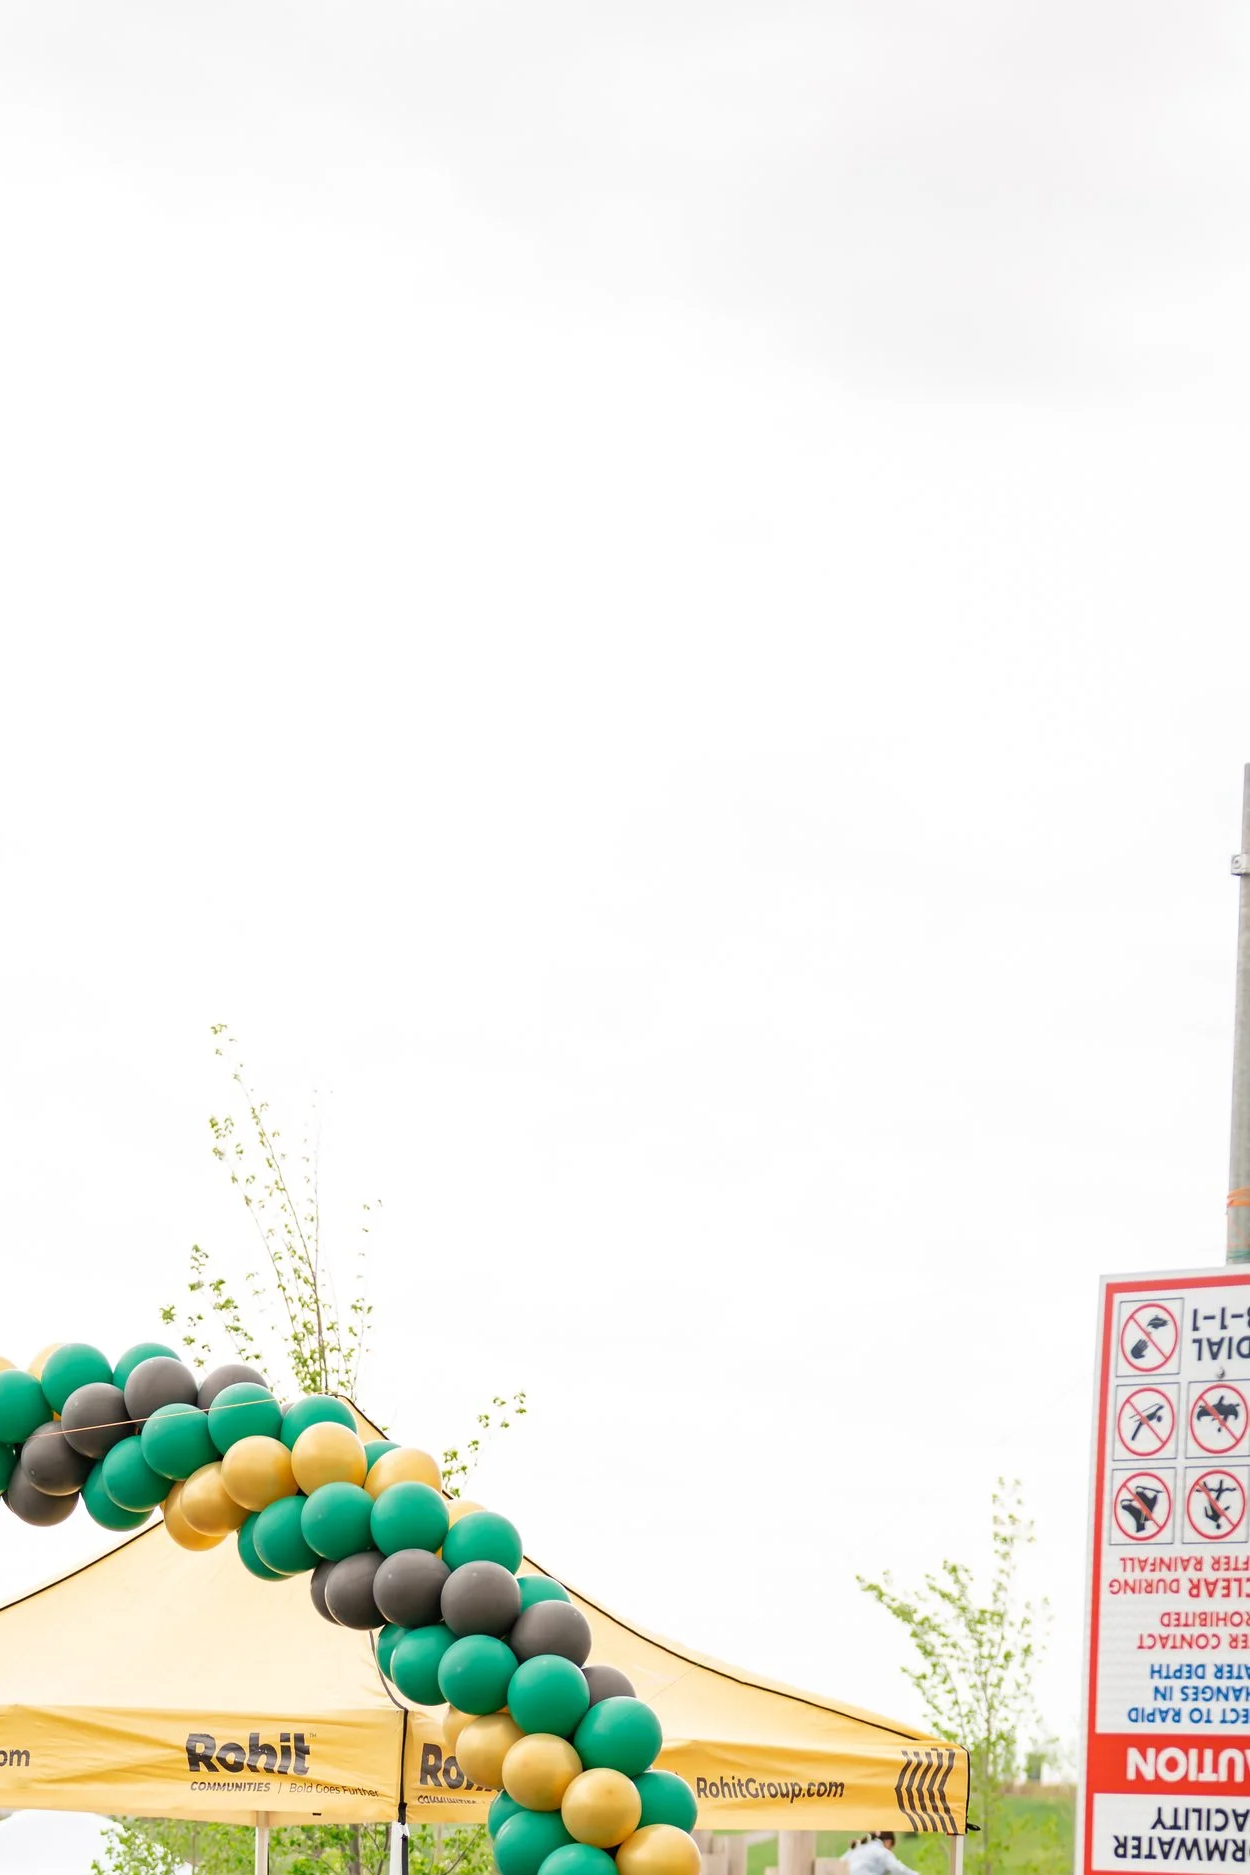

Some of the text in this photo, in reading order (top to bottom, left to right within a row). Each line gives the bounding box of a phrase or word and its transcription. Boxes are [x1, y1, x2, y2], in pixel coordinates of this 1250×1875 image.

[1192, 1306, 1250, 1332] -1-1
[1192, 1335, 1250, 1361] DIAL
[1119, 1555, 1204, 1573] RAINFALL
[1109, 1577, 1180, 1596] DURING
[1137, 1633, 1250, 1650] ER CONTACT
[1150, 1663, 1206, 1680] DEPTH
[1154, 1685, 1173, 1701] IN
[1127, 1707, 1182, 1724] RAPID
[1189, 1708, 1213, 1724] TO
[186, 1732, 310, 1776] Rohit
[1126, 1746, 1250, 1783] UTION
[190, 1781, 271, 1793] COMMUNITIES
[289, 1782, 380, 1798] Bold Goes Further
[696, 1776, 845, 1804] RohitGroup.com
[1151, 1806, 1250, 1832] ACILITY
[1113, 1835, 1250, 1863] RMWATER
